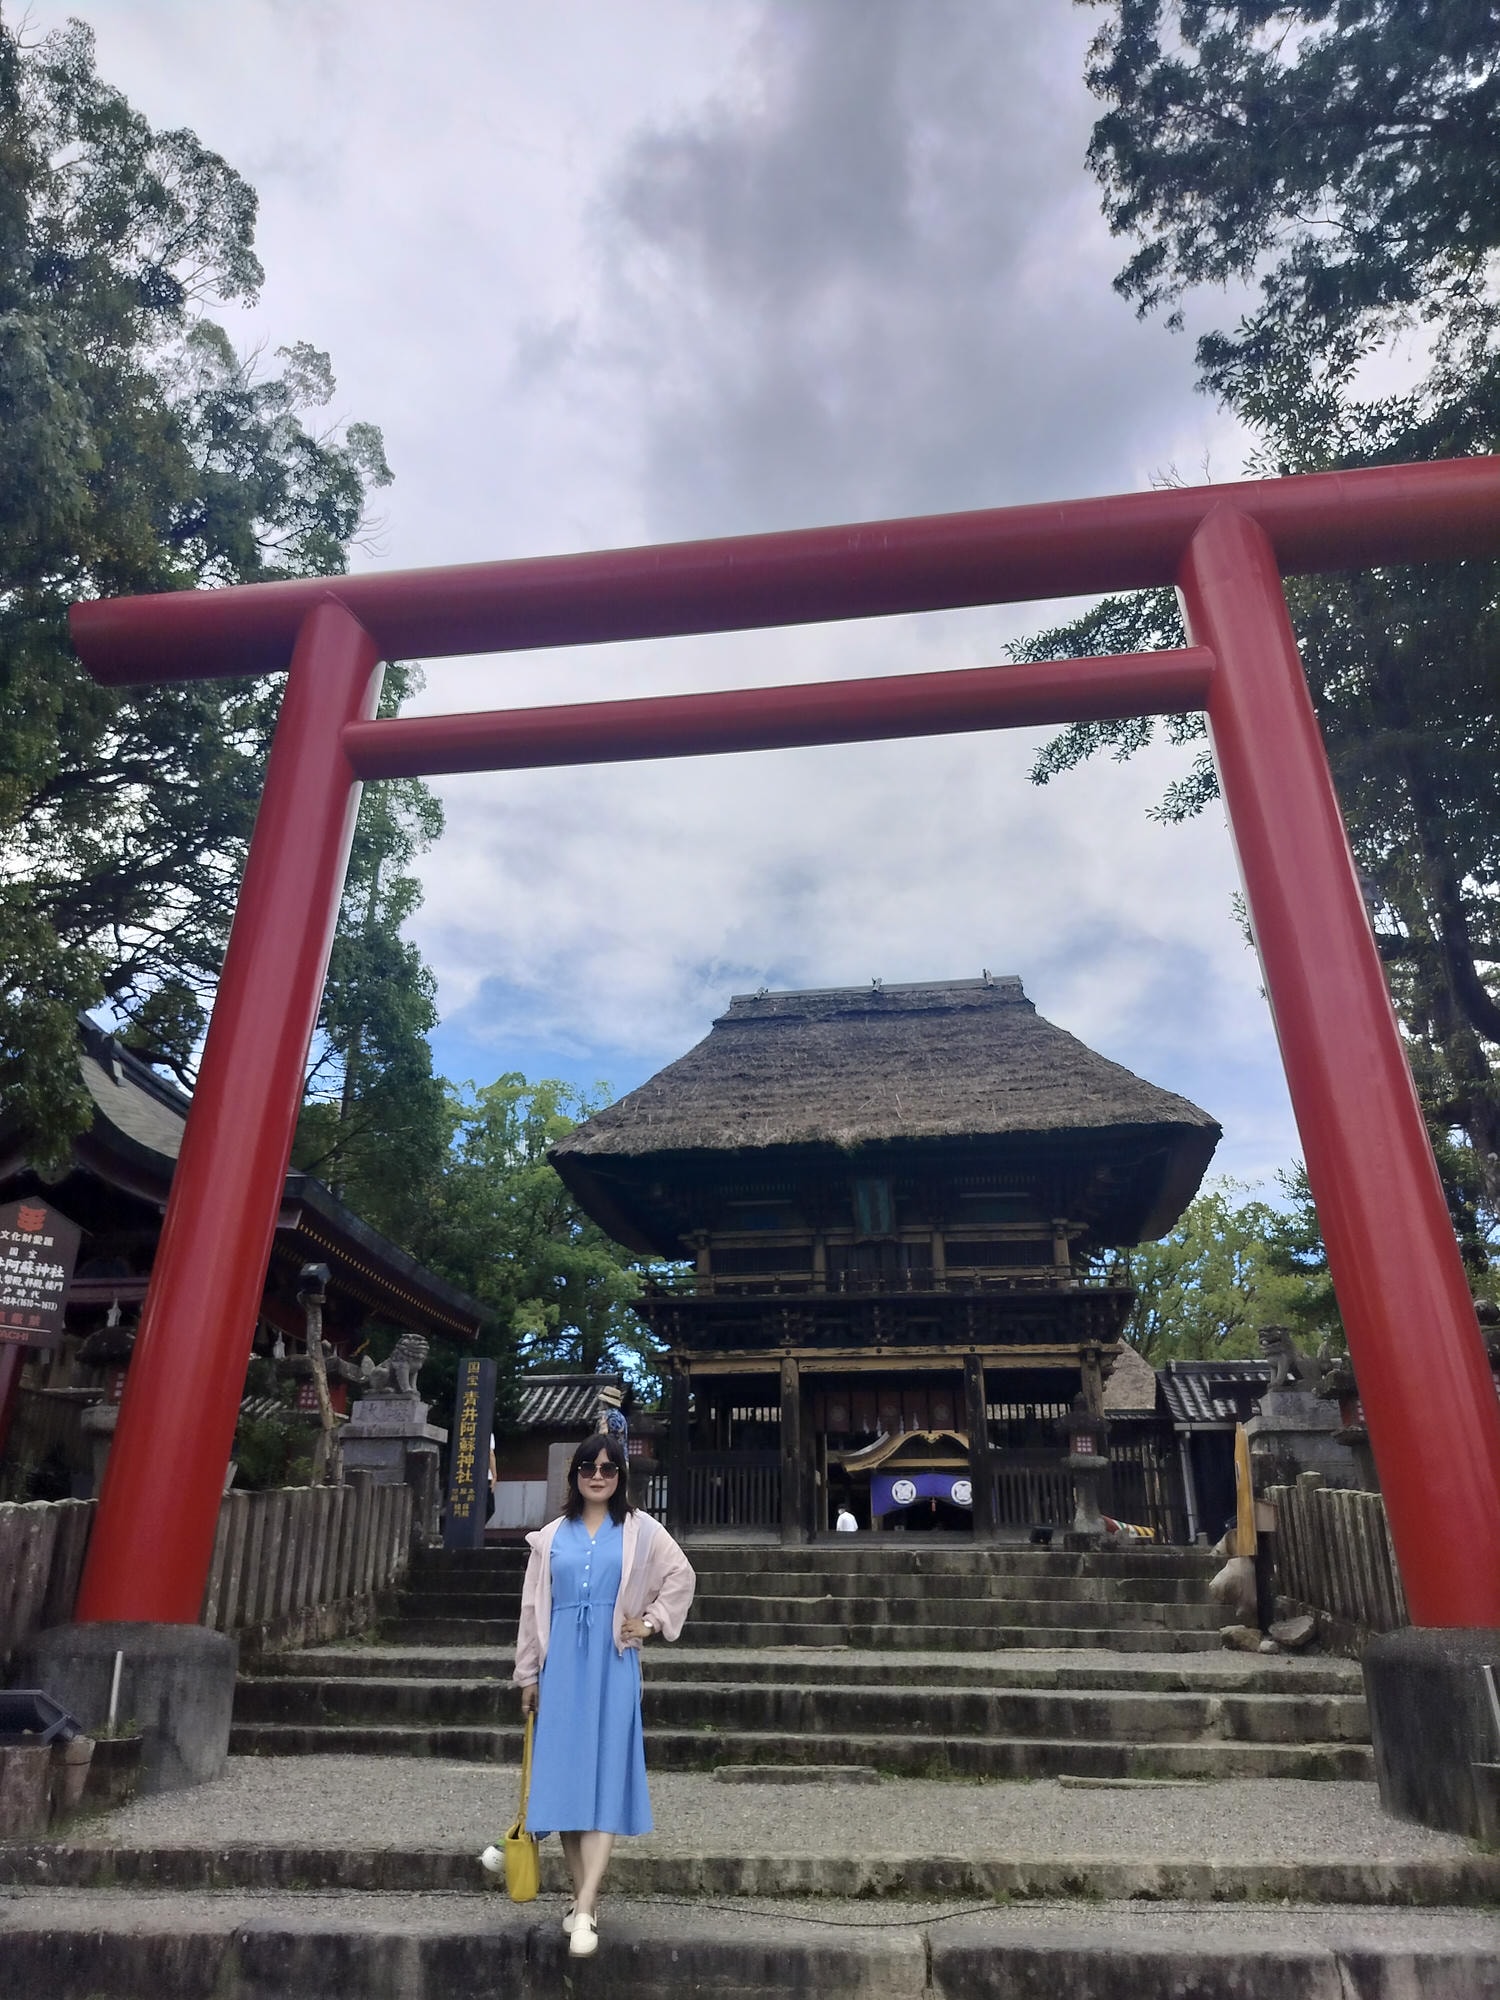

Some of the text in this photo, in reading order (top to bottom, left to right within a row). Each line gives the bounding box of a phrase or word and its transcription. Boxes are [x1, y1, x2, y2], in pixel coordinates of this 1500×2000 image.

[456, 1390, 480, 1485] 青井阿蘇神社
